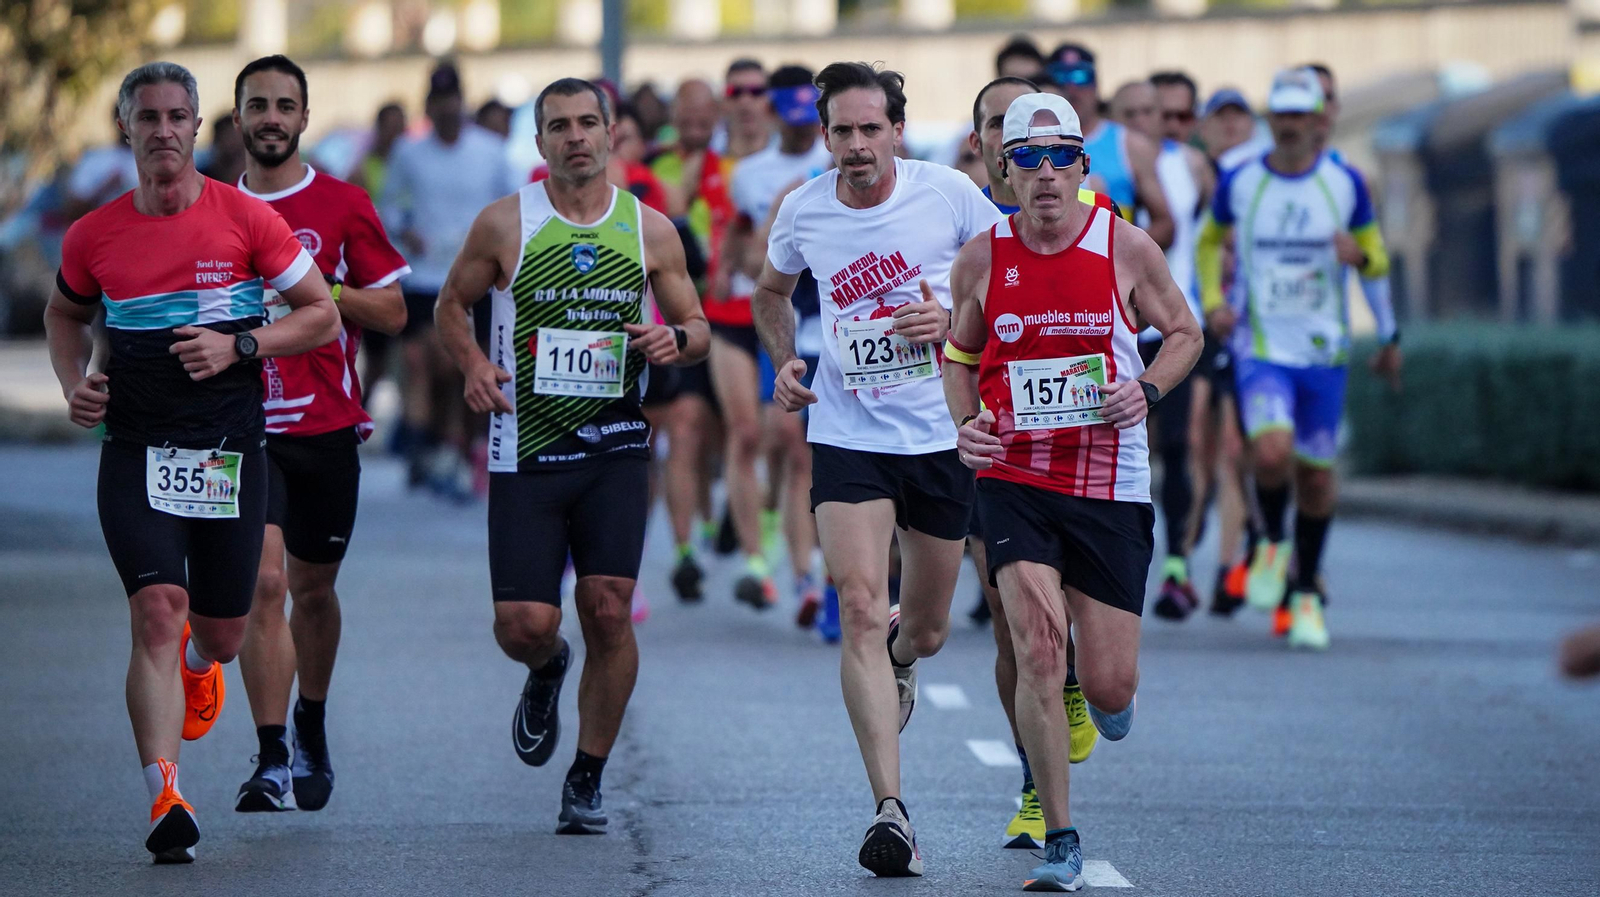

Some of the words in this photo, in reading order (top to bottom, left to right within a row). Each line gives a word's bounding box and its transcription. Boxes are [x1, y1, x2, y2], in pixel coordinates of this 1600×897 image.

[197, 260, 214, 269] Find
[215, 260, 234, 270] Your
[830, 267, 850, 288] XXVI
[848, 251, 879, 276] MEDIA
[195, 271, 233, 284] EVEREST
[830, 250, 909, 311] MARATÓN
[893, 277, 904, 289] DE
[534, 288, 558, 302] C.D.
[561, 288, 579, 300] LA
[1023, 309, 1071, 326] muebles
[1074, 309, 1112, 327] miguel
[997, 322, 1020, 335] mm
[1050, 326, 1078, 335] medina
[1078, 326, 1106, 335] sidonia
[849, 336, 894, 366] 123
[548, 346, 593, 374] 110
[1023, 377, 1068, 406] 157
[600, 421, 647, 436] SIBELCO
[157, 465, 205, 494] 355
